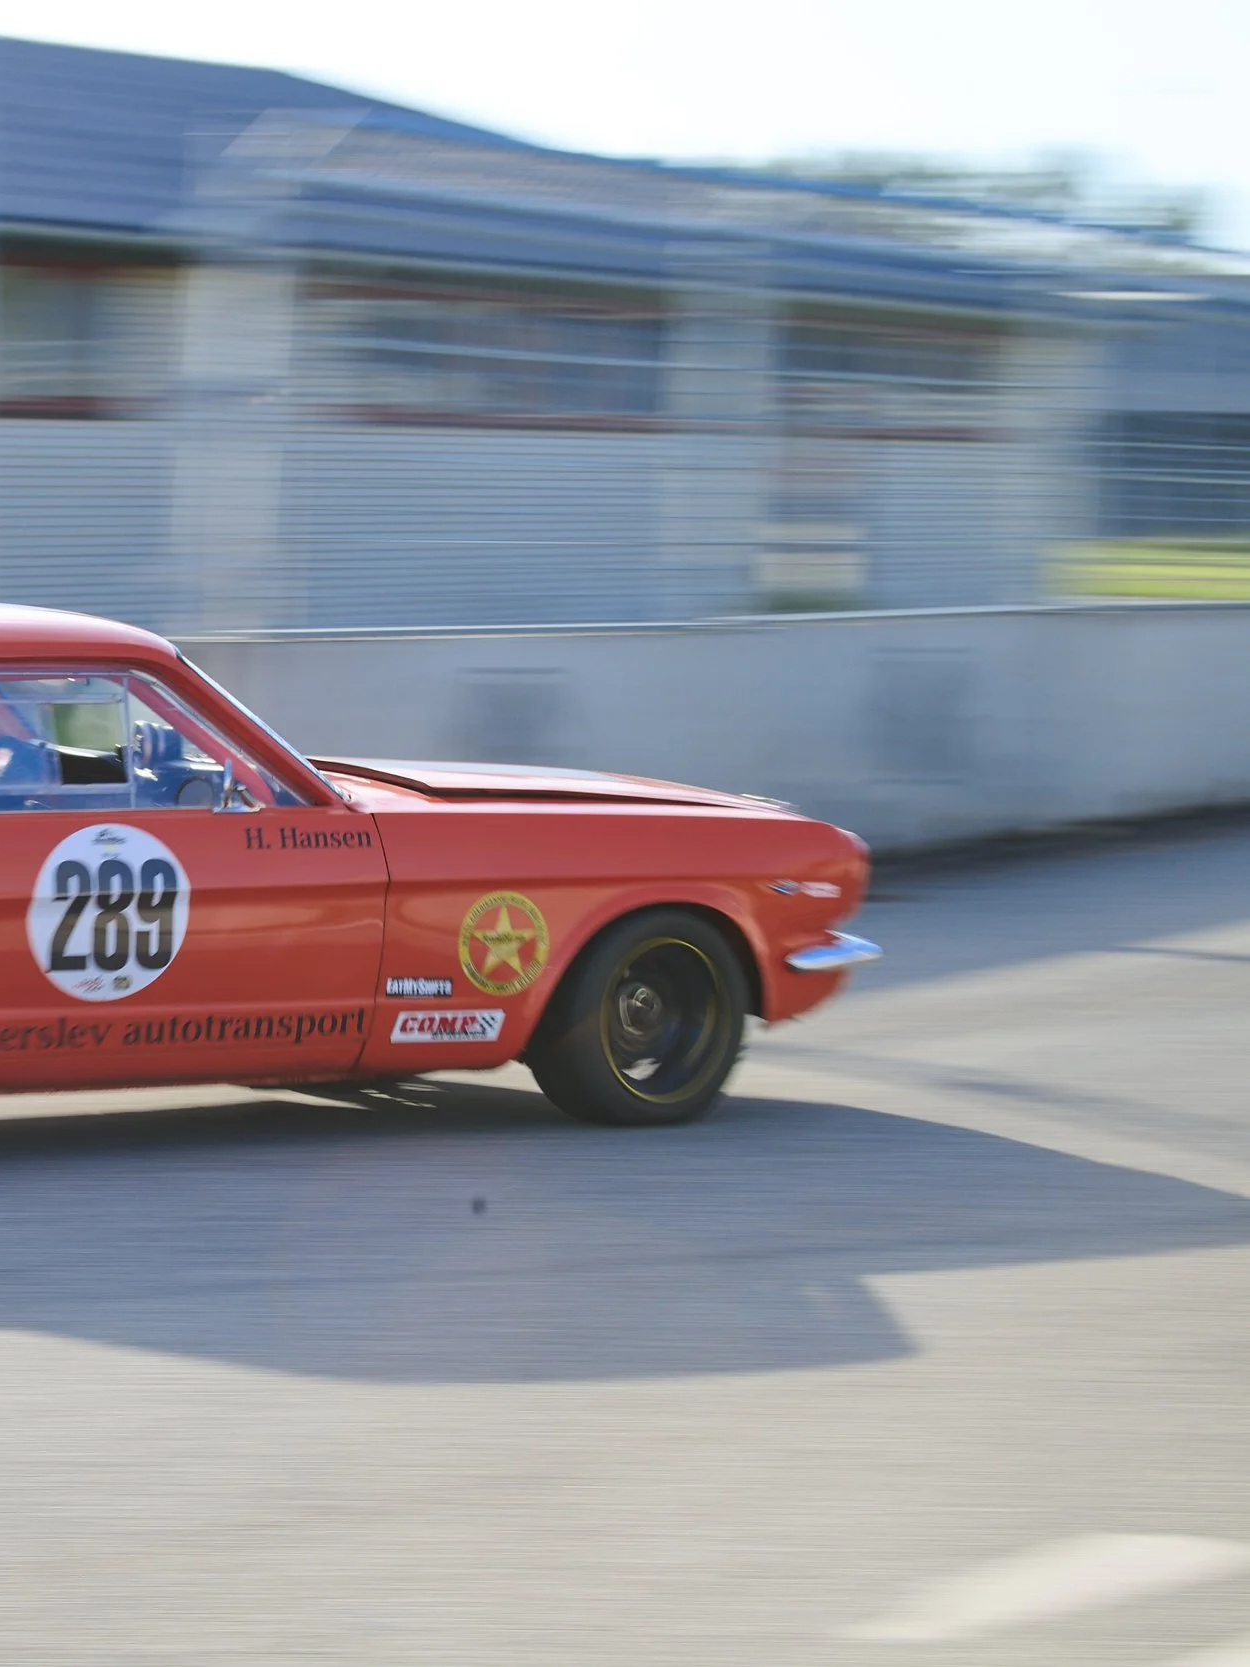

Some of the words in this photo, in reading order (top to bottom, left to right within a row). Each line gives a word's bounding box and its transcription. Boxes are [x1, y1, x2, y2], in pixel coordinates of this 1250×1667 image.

[244, 827, 271, 850] H.
[279, 826, 372, 849] Hansen
[46, 858, 178, 972] 289
[122, 1007, 366, 1045] autotransport
[399, 1014, 478, 1034] COMP
